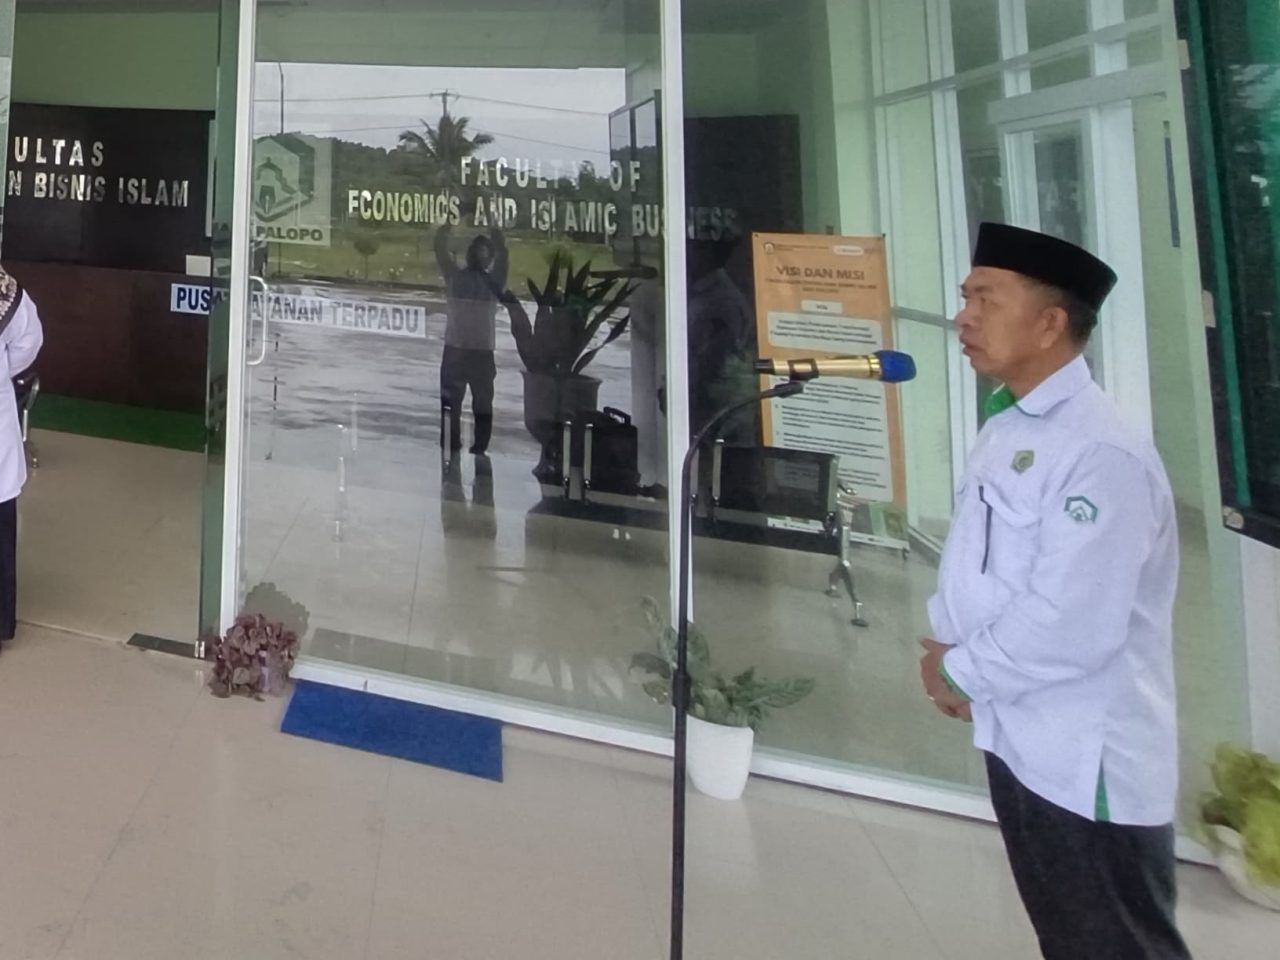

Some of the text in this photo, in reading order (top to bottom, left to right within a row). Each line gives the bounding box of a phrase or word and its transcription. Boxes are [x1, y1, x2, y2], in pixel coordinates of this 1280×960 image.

[14, 136, 104, 167] ULTAS
[33, 171, 106, 202] BISNIS
[118, 176, 189, 207] ISLAM
[609, 159, 641, 192] OF
[348, 189, 461, 226] ECONOMICS
[473, 195, 517, 228] AND
[256, 225, 323, 241] PALOPO
[775, 265, 865, 280] VISI DAN MISI
[330, 301, 420, 334] TERPADU
